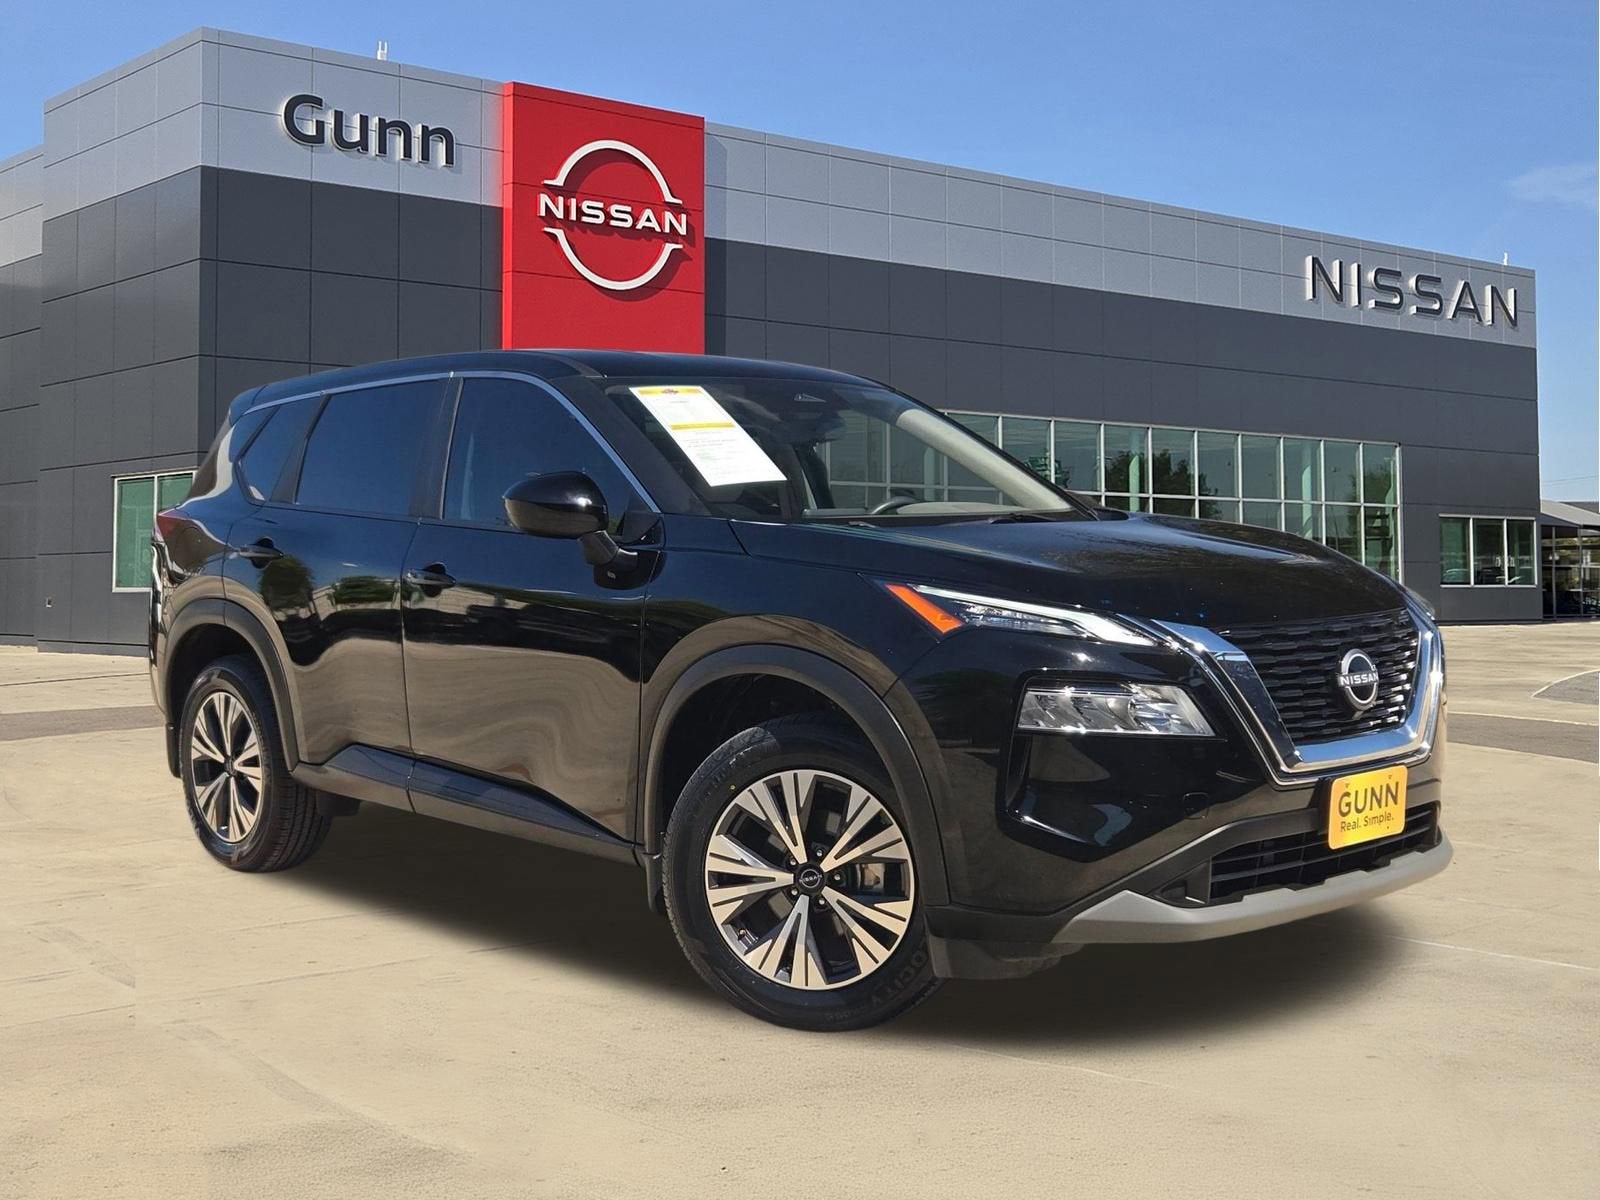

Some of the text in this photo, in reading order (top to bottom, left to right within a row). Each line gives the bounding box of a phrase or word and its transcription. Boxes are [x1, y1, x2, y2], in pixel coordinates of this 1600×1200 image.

[281, 93, 456, 168] Gunn
[537, 192, 688, 236] NISSAN
[1304, 255, 1519, 327] NISSAN
[1340, 672, 1379, 687] NISSAN
[1338, 781, 1399, 818] GUNN
[1340, 810, 1395, 833] Real. Simple.
